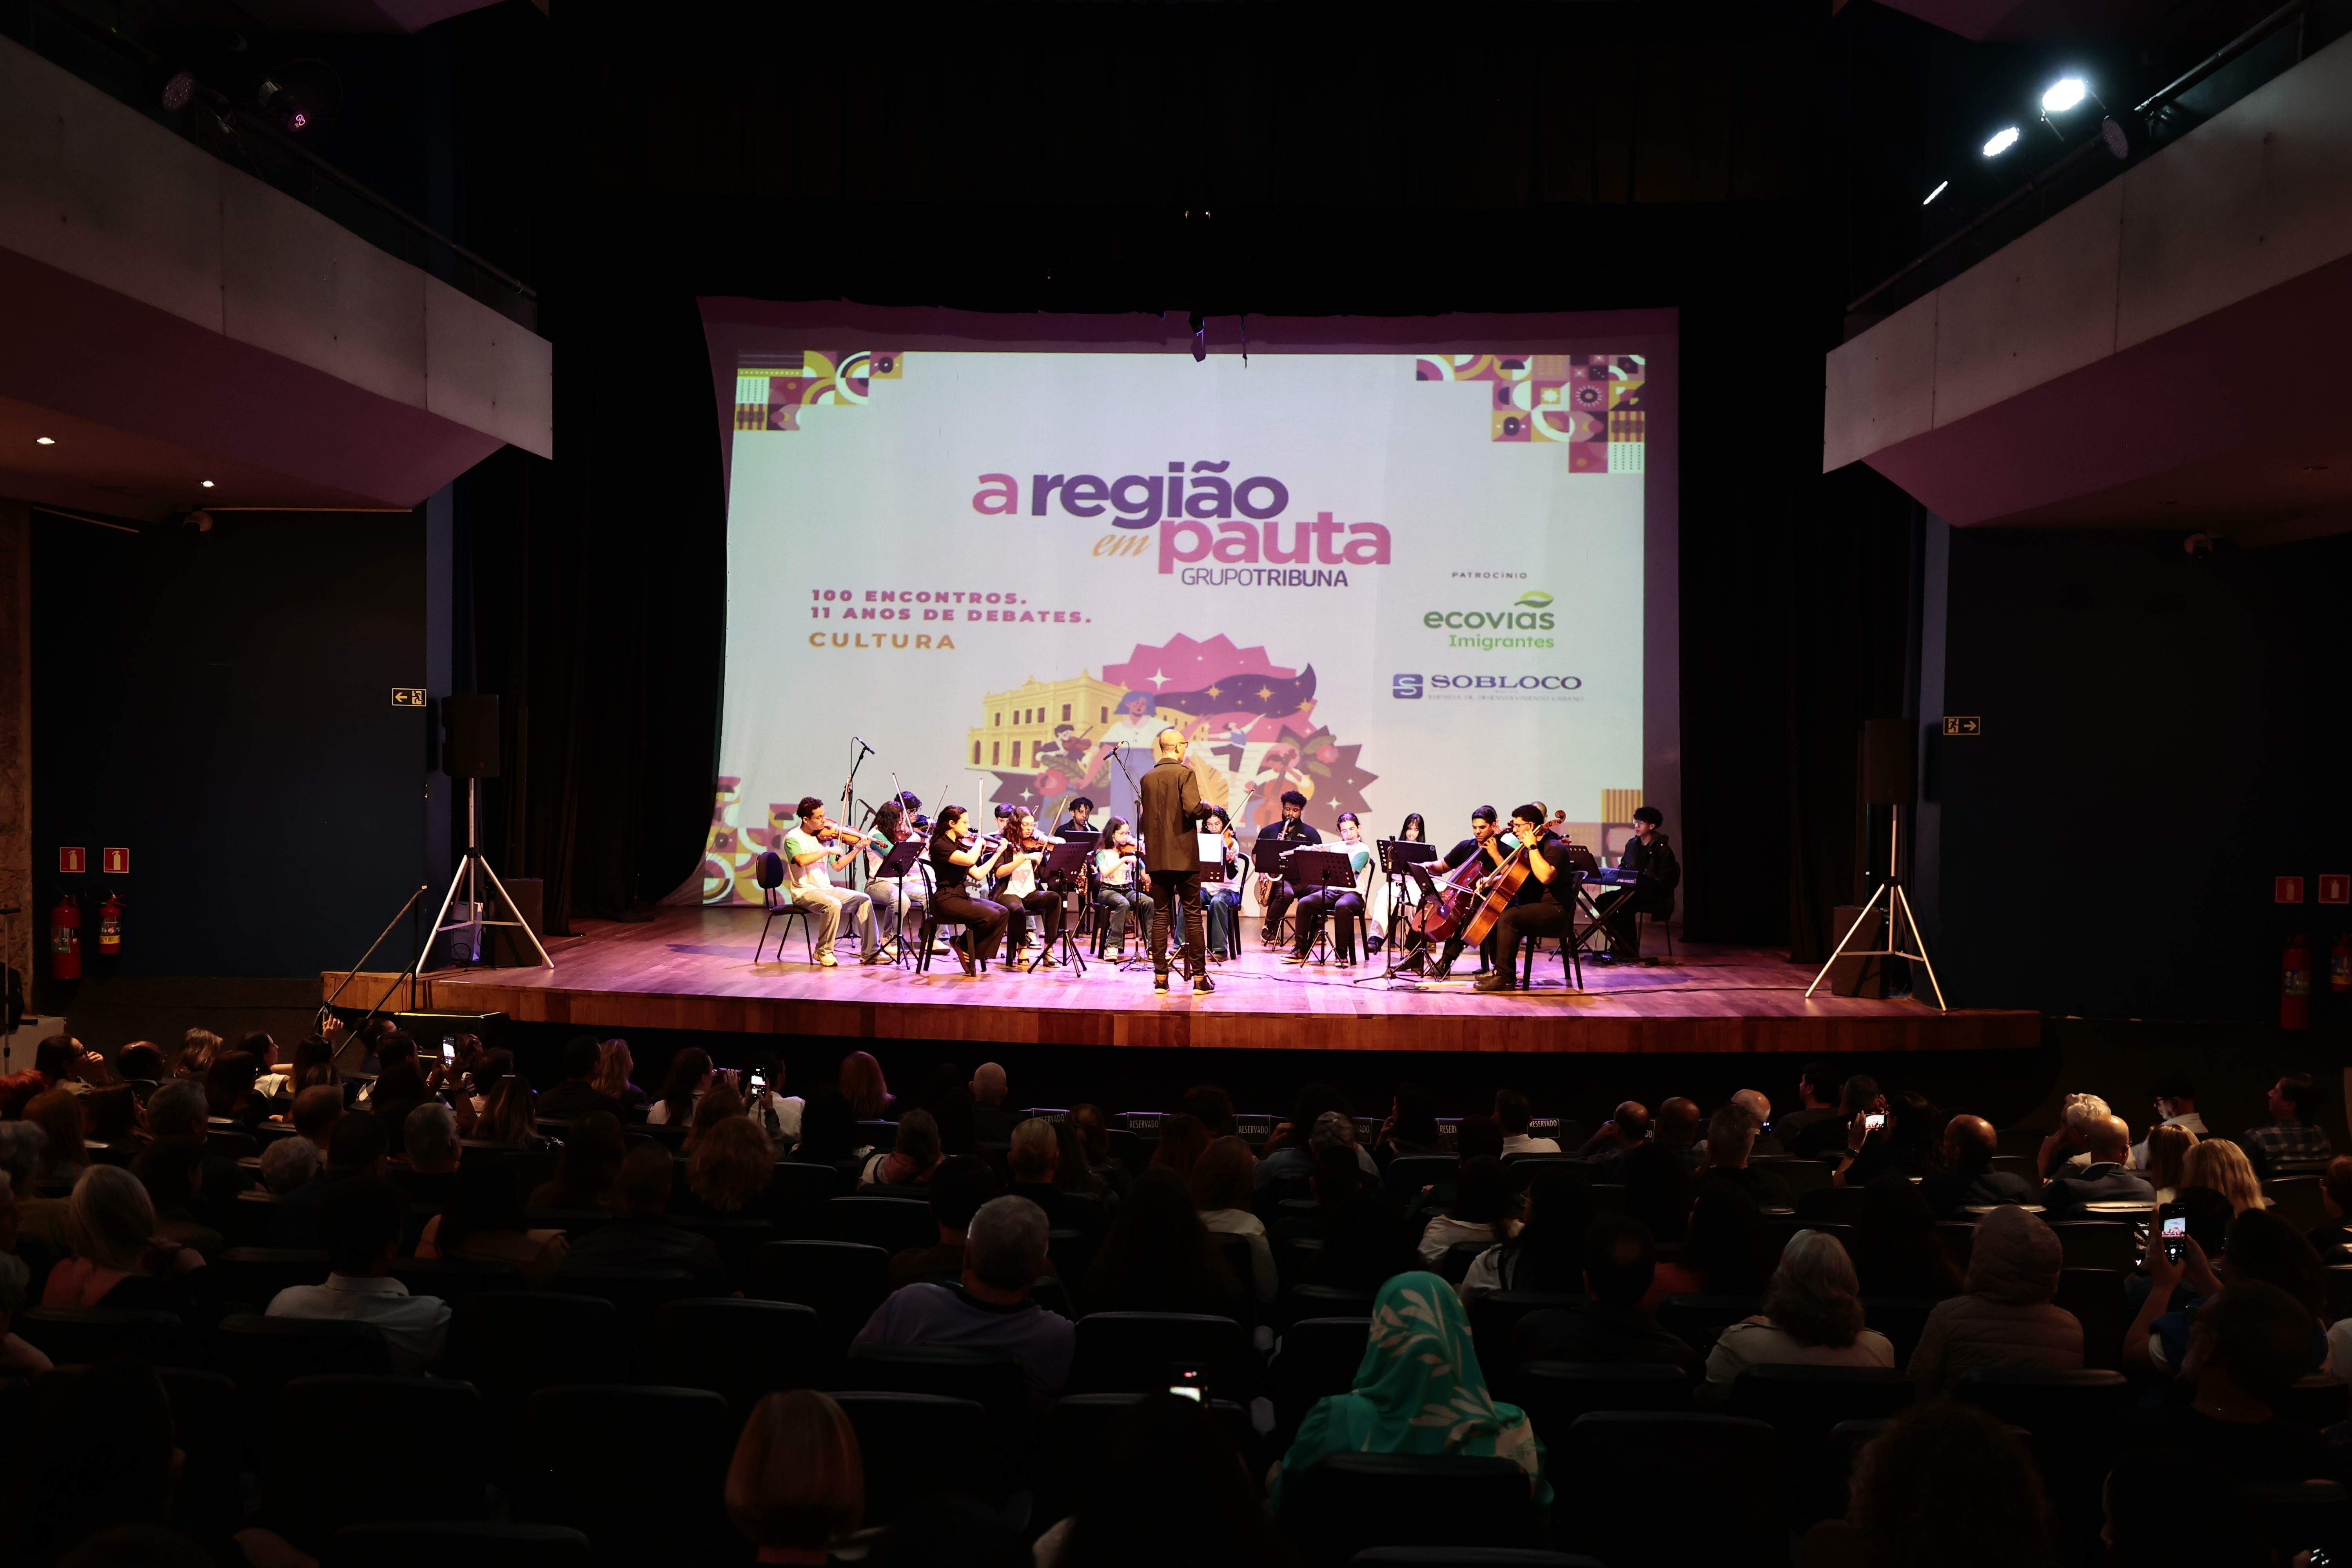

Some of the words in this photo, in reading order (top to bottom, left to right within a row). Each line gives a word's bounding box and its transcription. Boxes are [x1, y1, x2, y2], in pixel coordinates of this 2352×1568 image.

[972, 473, 1018, 515] a
[1031, 460, 1289, 529] região
[1092, 532, 1152, 558] em
[1158, 512, 1391, 574] pauta
[1181, 567, 1349, 587] GRUPOTRIBUNA
[812, 589, 852, 602] 100
[865, 590, 1026, 604] ENCONTROS.
[811, 607, 830, 619] 11
[842, 608, 910, 620] ANOS
[924, 609, 954, 621] DE
[967, 610, 1091, 623] DEBATES.
[1423, 610, 1555, 630] ecovias
[808, 632, 955, 650] CULTURA
[1449, 633, 1555, 651] Imigrantes
[1431, 675, 1582, 690] SOBLOCO
[1129, 1120, 1159, 1128] RESERVADO
[1238, 1125, 1268, 1134] RESERVADO
